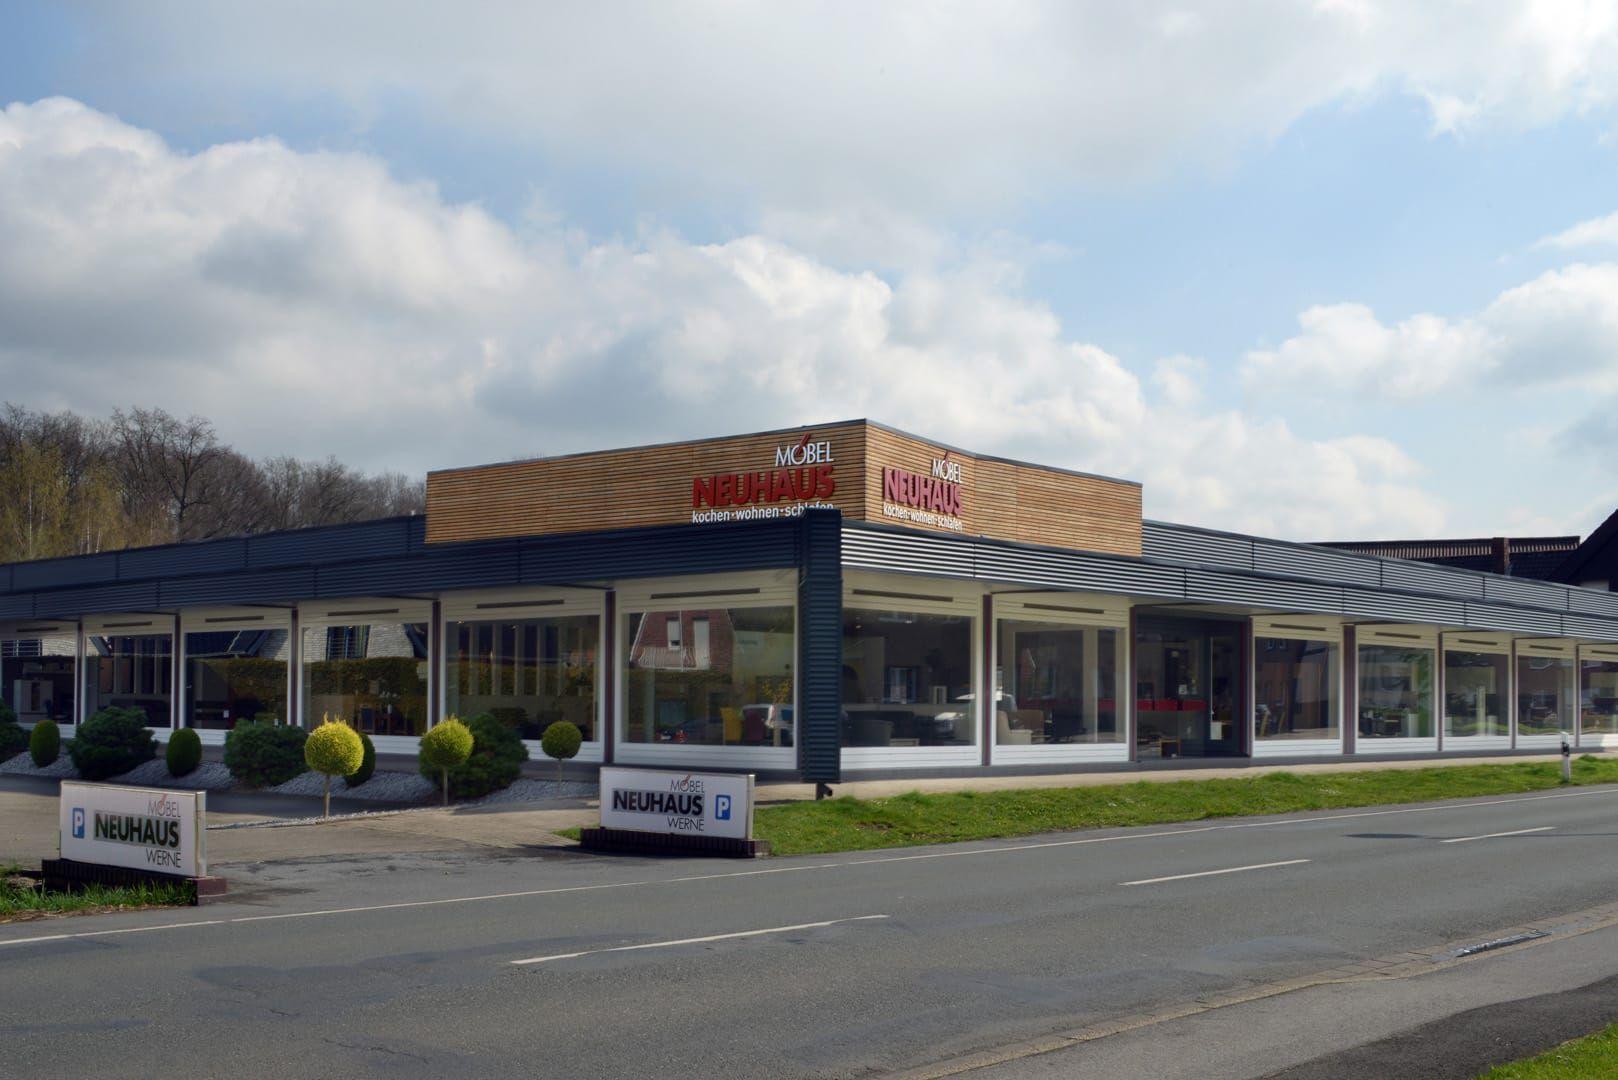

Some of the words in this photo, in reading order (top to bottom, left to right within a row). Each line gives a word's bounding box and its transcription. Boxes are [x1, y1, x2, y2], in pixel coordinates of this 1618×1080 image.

[692, 465, 835, 508] NEUHAUS
[883, 466, 963, 517] NEUHAUS
[613, 791, 703, 815] NEUHAUS
[717, 796, 730, 819] P
[74, 809, 84, 837] P
[95, 813, 180, 848] NEUHAUS
[667, 817, 704, 831] WERNE
[146, 847, 181, 868] WERNE
